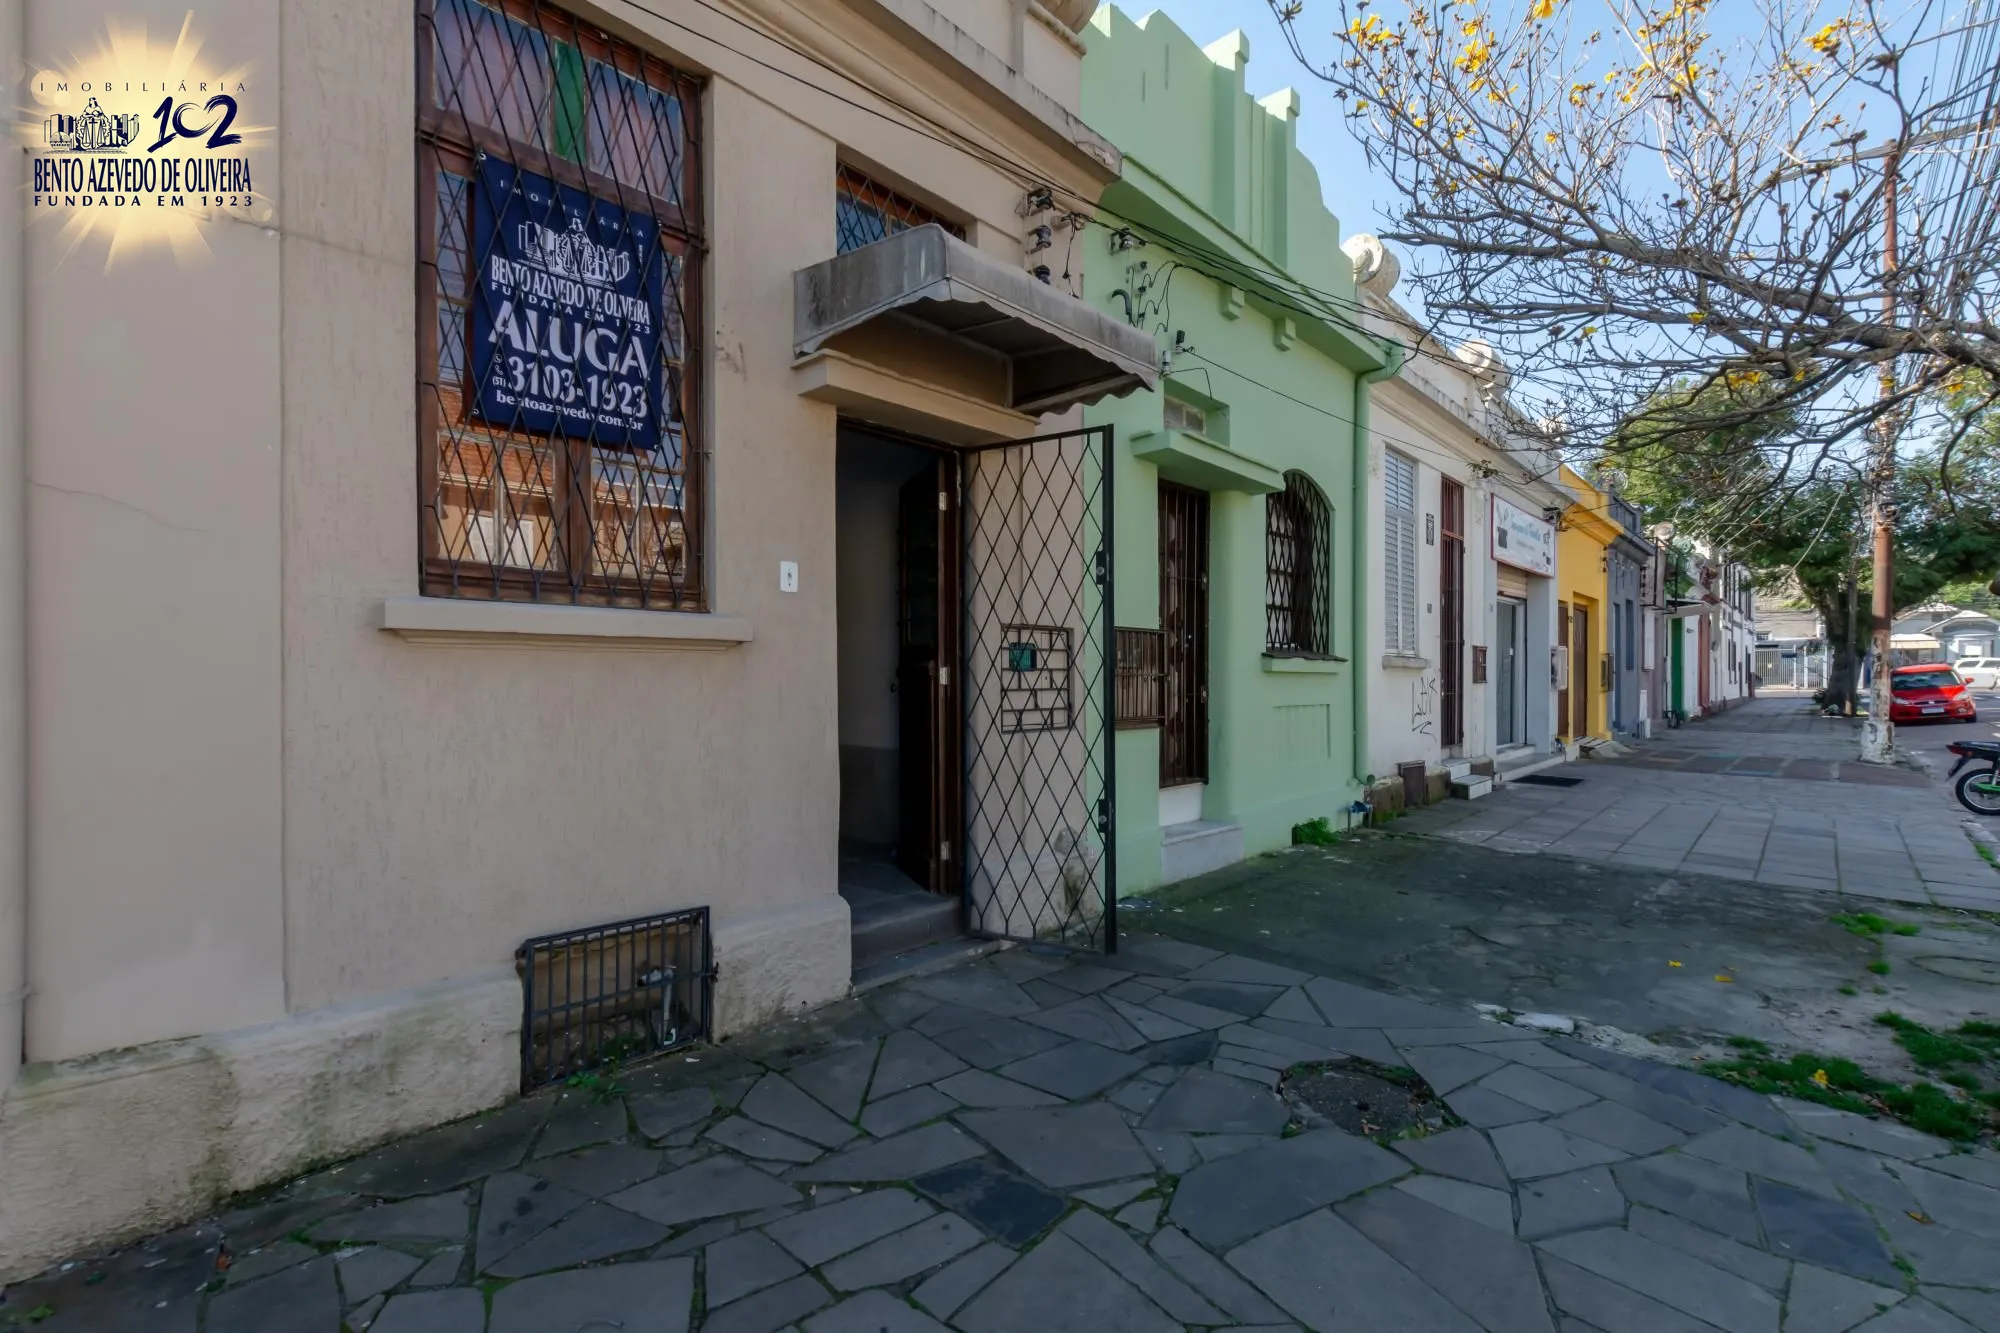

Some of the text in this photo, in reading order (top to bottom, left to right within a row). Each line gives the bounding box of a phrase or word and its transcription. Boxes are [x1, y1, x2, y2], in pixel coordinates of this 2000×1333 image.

[491, 254, 650, 325] BENTO AZEVEDO DE OLIVEIRA
[492, 281, 650, 335] FUDAA EM 123
[488, 300, 651, 381] ALUGA
[492, 356, 647, 418] (51) 3103-1923
[496, 390, 644, 431] betoazevedocom.br
